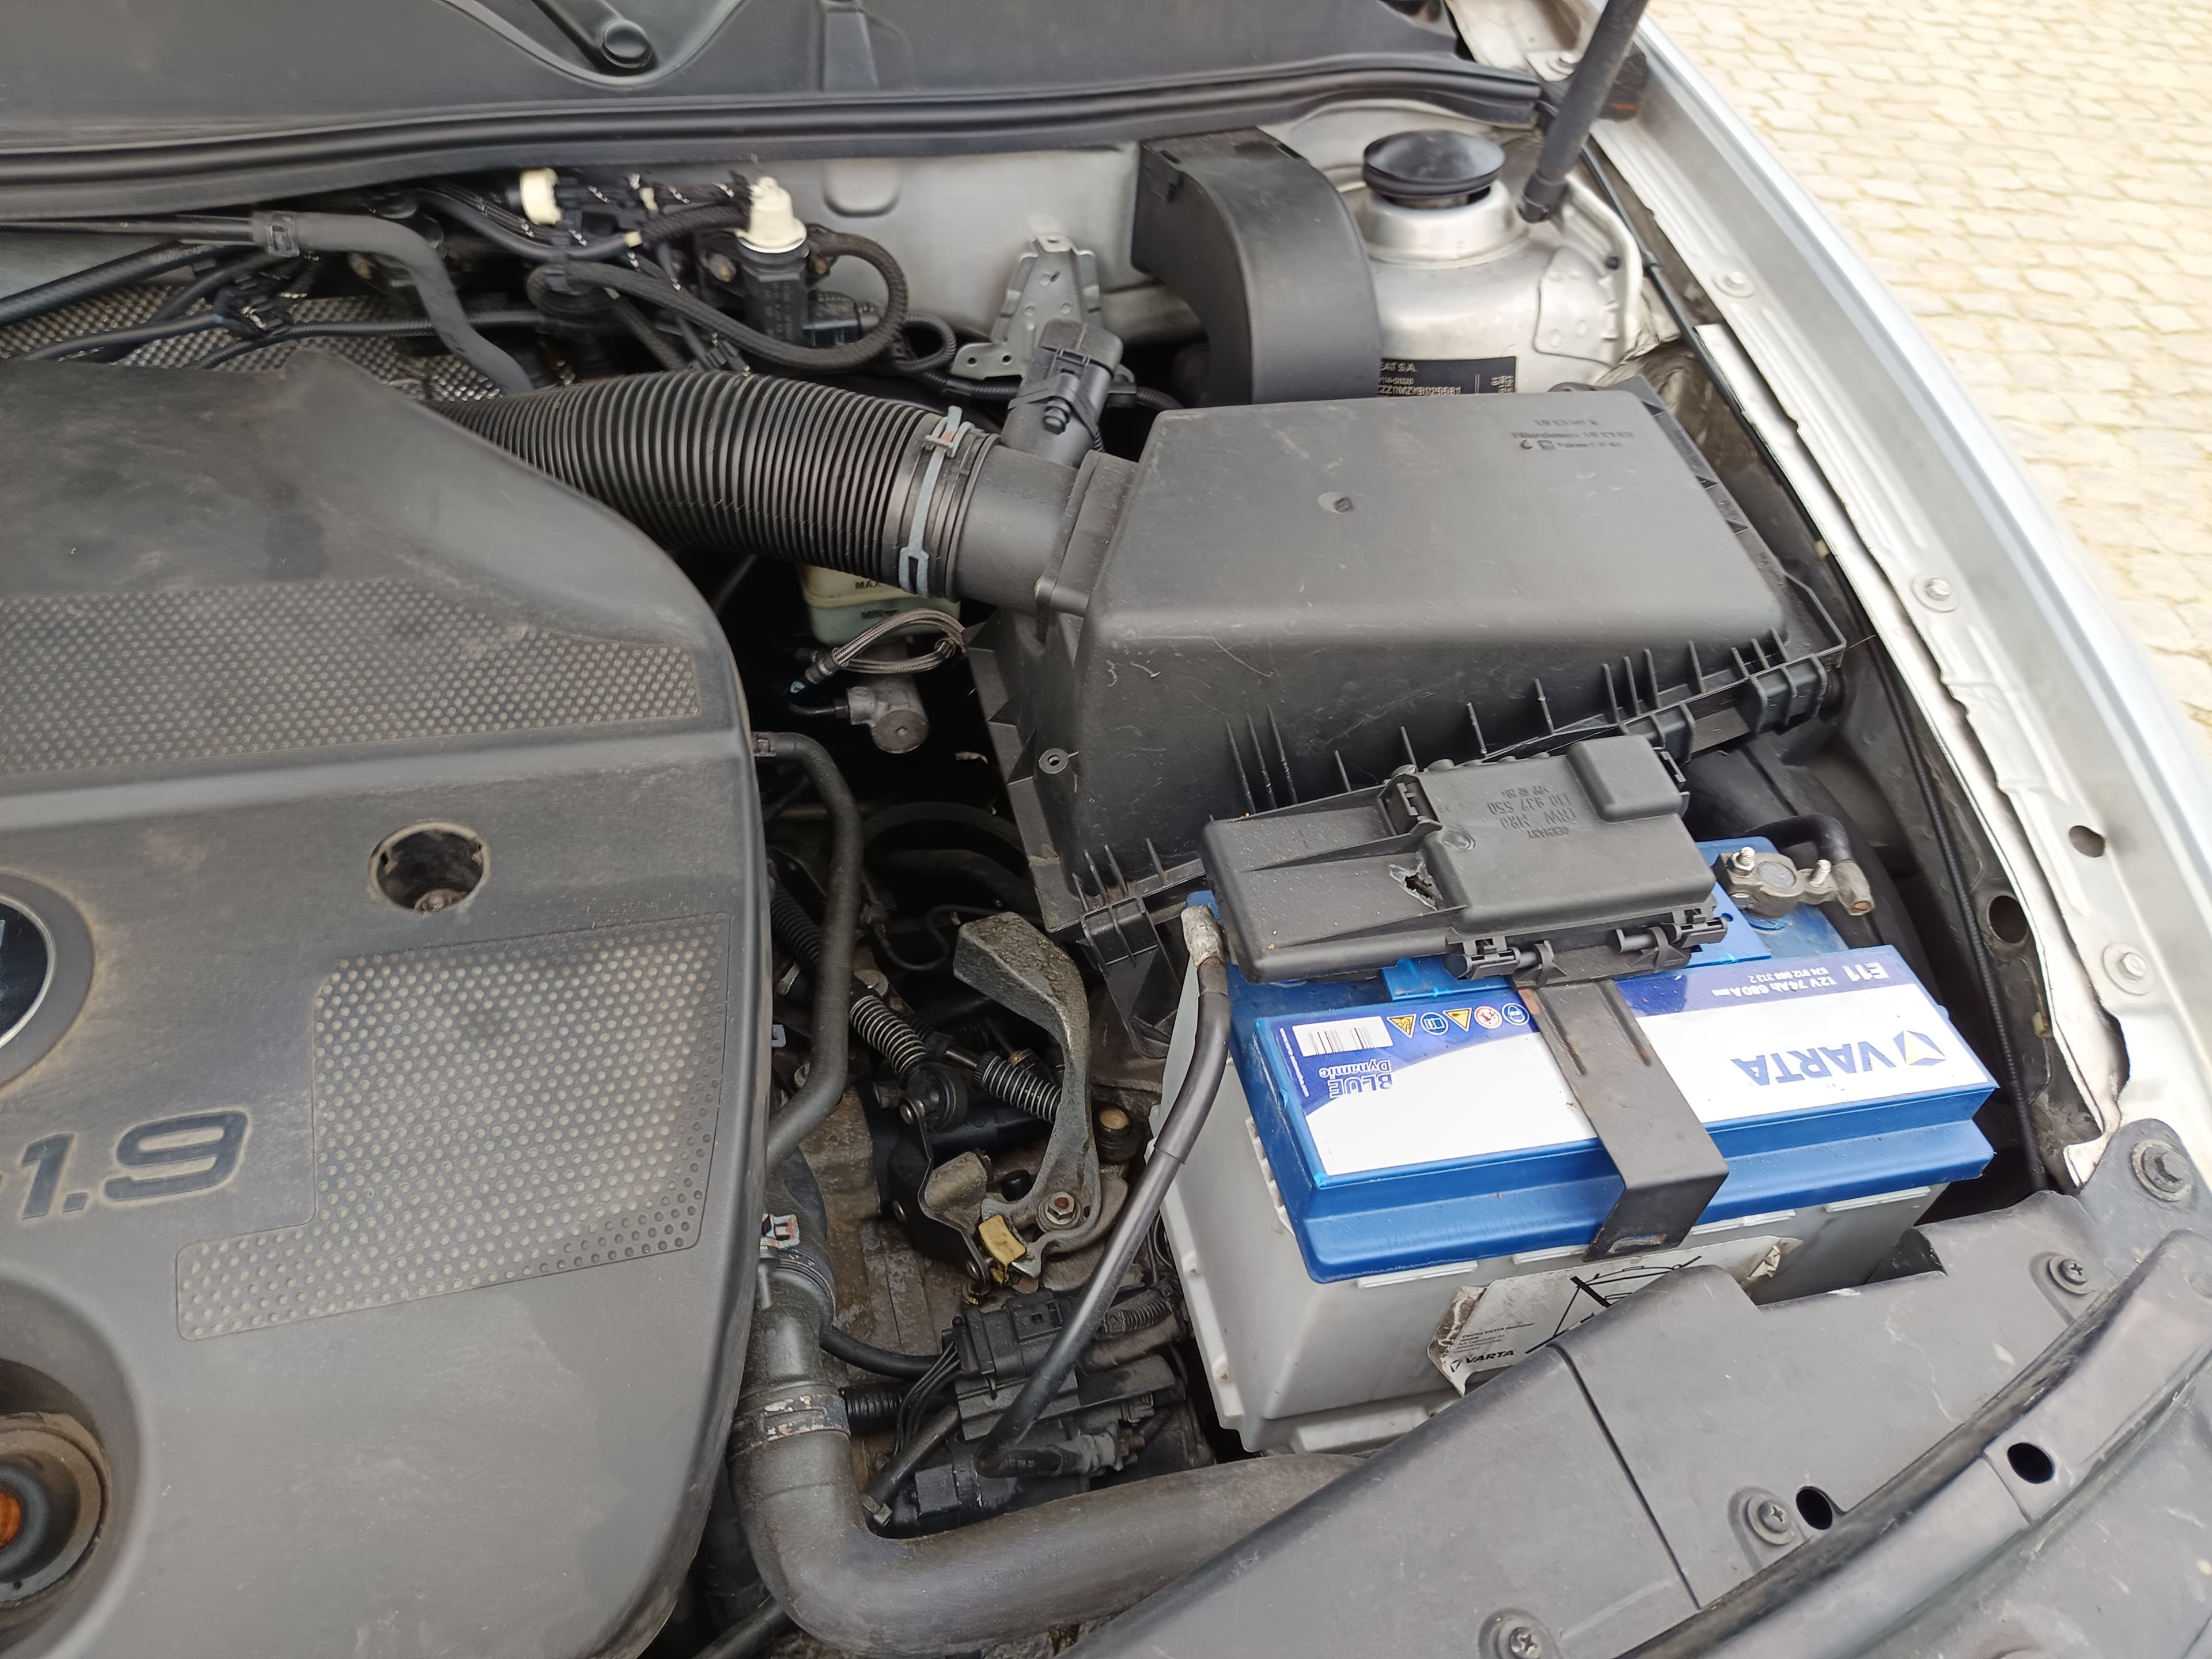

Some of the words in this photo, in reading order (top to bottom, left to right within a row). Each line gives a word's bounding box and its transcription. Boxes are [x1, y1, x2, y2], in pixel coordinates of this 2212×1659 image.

[855, 579, 881, 589] MAX
[1487, 801, 1514, 815] 550
[1521, 797, 1544, 811] 937
[1545, 808, 1580, 824] TRW
[1528, 825, 1570, 839] GERMANY
[1756, 972, 1772, 982] 313
[1810, 967, 1830, 975] 574
[1842, 962, 1890, 982] E11
[1748, 975, 1756, 984] 2
[1770, 978, 1808, 992] 74Ah
[1810, 976, 1838, 988] 12V
[1319, 1059, 1391, 1079] Dynamic
[1730, 1041, 1897, 1086] VARTA
[1327, 1073, 1392, 1099] BLUE
[21, 1110, 248, 1219] 1.9
[1465, 1350, 1514, 1363] VARTA
